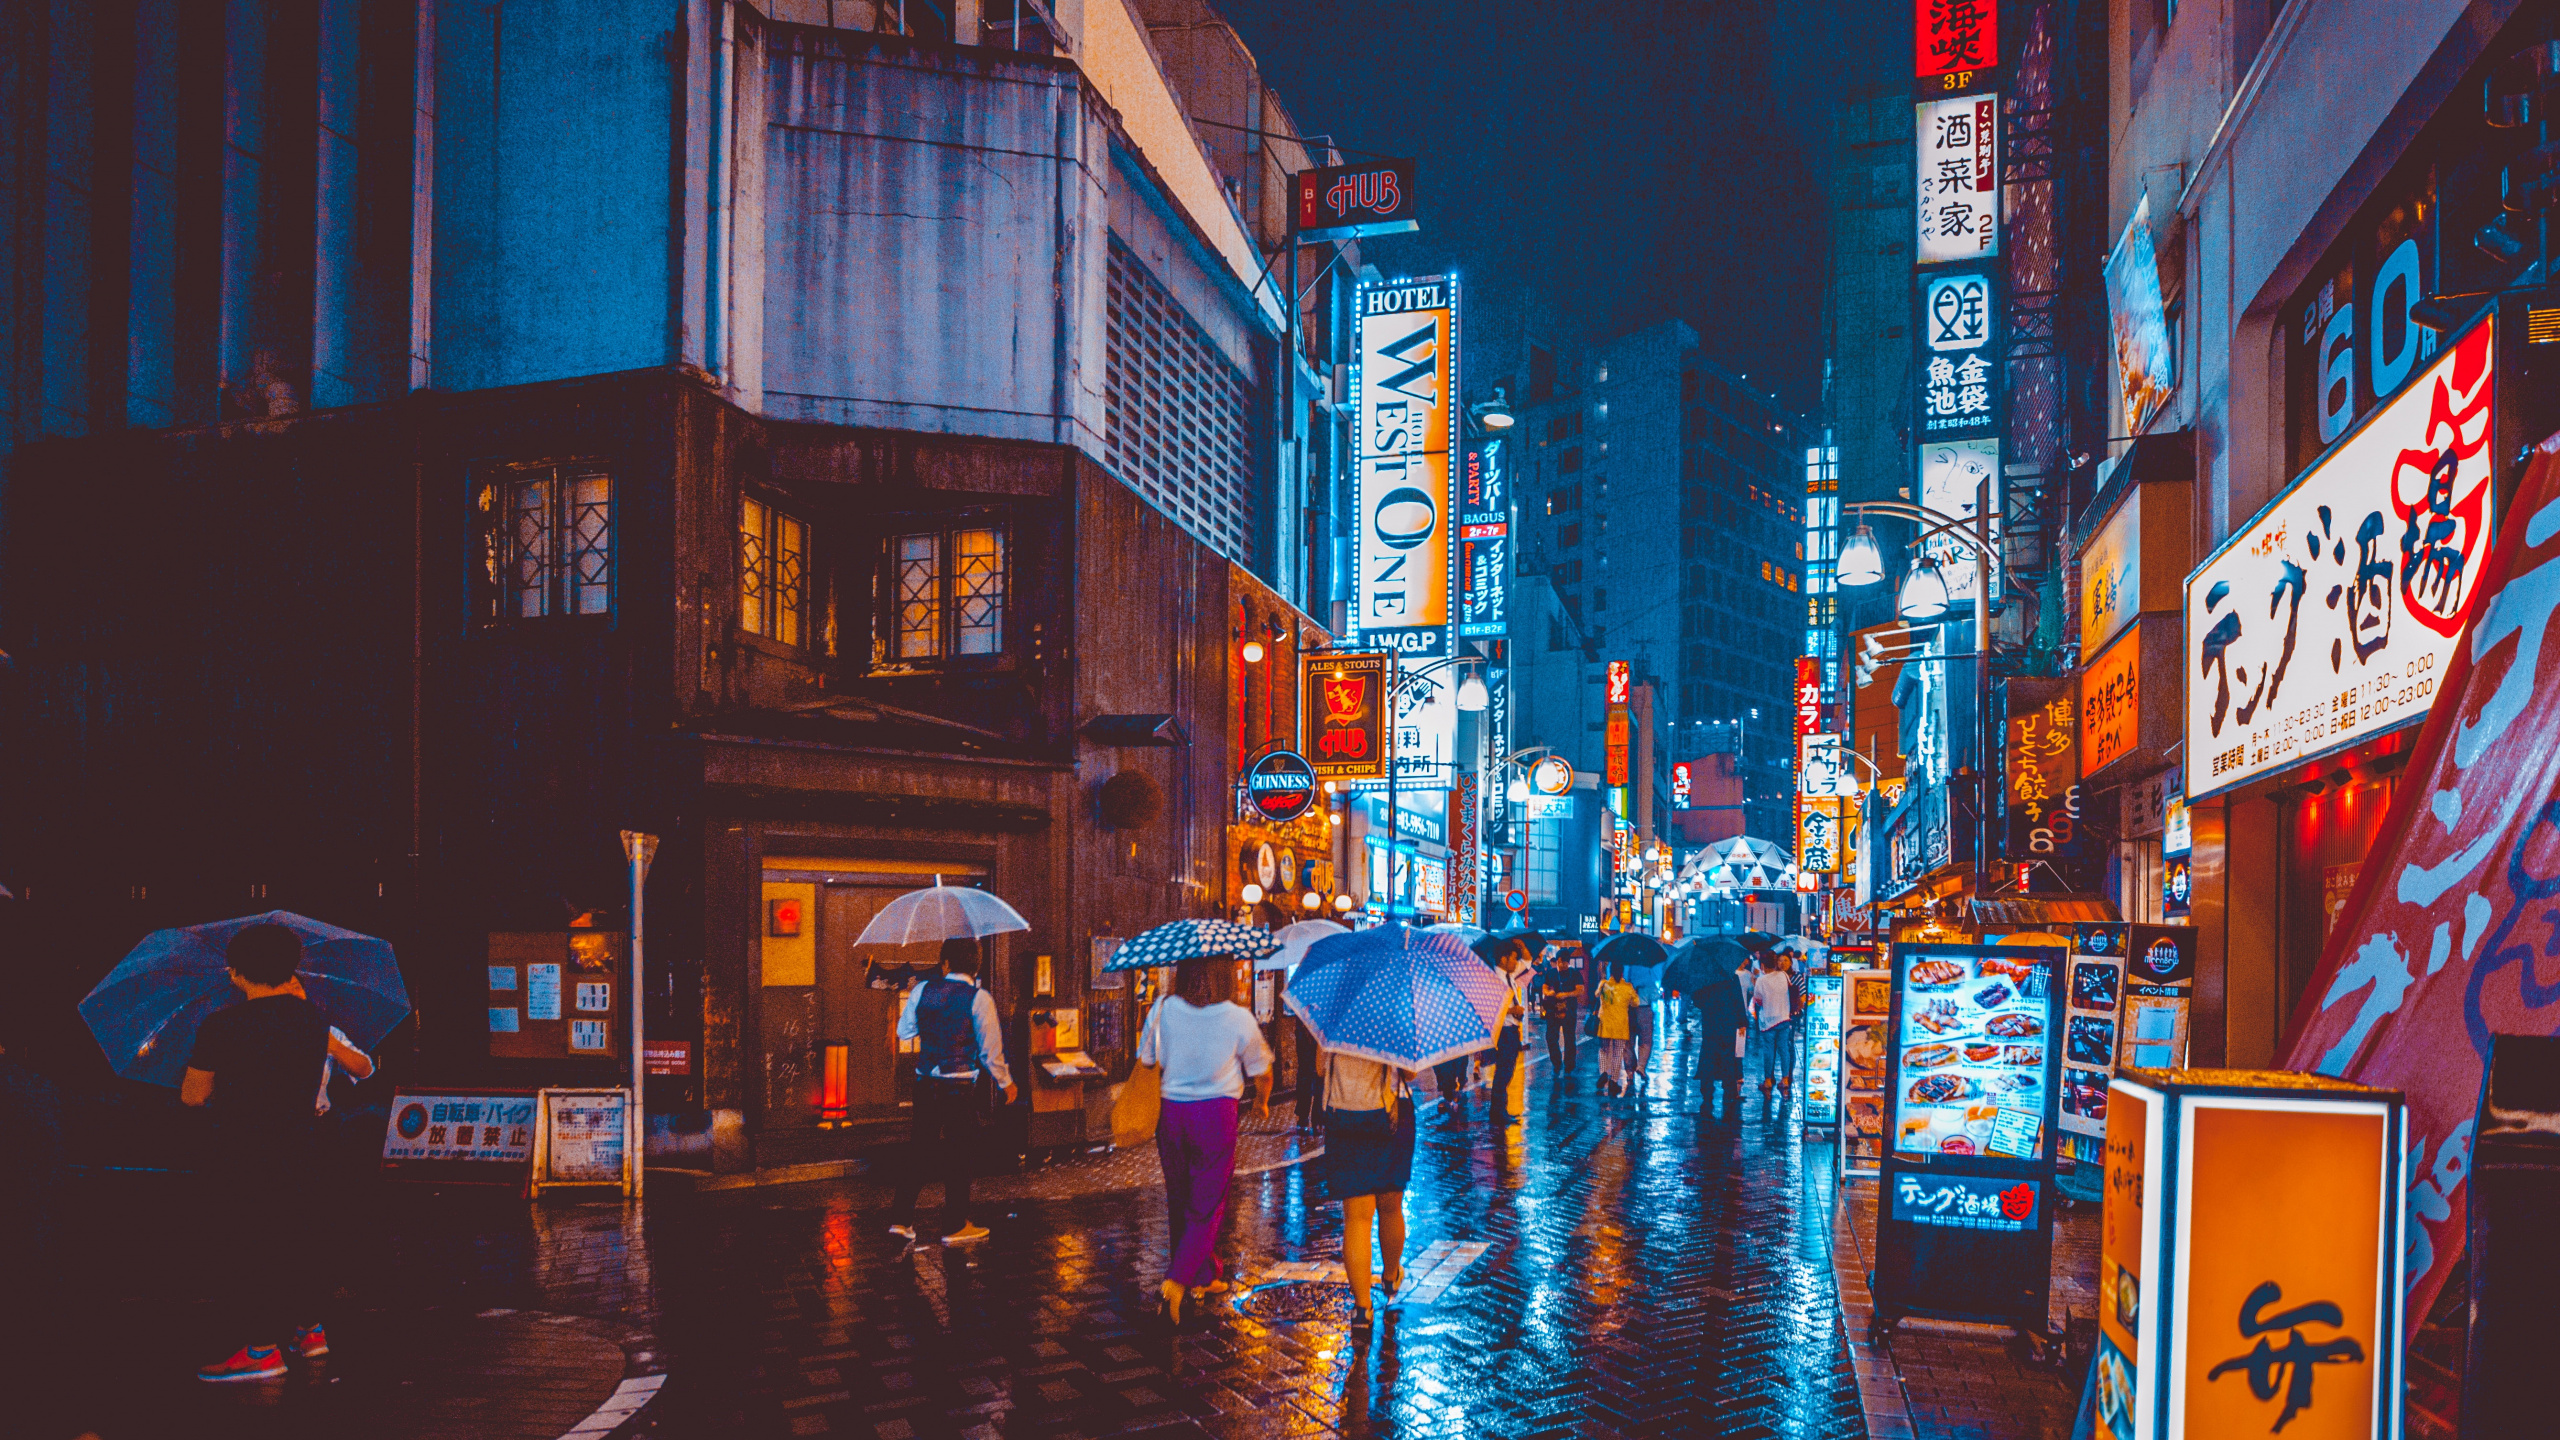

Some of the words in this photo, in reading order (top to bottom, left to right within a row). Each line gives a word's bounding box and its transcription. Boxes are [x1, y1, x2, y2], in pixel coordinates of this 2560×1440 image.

[1943, 71, 1972, 90] 3F
[1936, 114, 1974, 236] 酒菜家
[1327, 170, 1400, 218] HUB
[1921, 178, 1935, 241] さかなや
[1979, 214, 1993, 250] 2F
[1367, 286, 1446, 315] HOTEL
[1926, 353, 1992, 388] 魚金
[1373, 316, 1438, 480] WEST
[1926, 386, 1991, 415] 池袋
[1411, 411, 1424, 466] HOTEL
[1926, 415, 1992, 430] 創業昭和48年
[1468, 462, 1480, 505] PARTY
[1484, 440, 1501, 511] ダーツバー
[1464, 512, 1505, 524] BAGUS
[1469, 526, 1499, 537] 2F-7F
[1373, 486, 1437, 618] ONE
[1490, 540, 1503, 621] インターネット
[2201, 448, 2465, 738] テング酒場
[1465, 626, 1503, 636] B1F-B2F
[1310, 662, 1334, 672] ALES
[1344, 660, 1380, 670] STOUTS
[1800, 684, 1819, 734] カラ
[1319, 728, 1368, 759] HUB
[1252, 773, 1310, 790] GUINNESS
[1346, 765, 1376, 775] CHIPS
[1803, 811, 1832, 871] 金の蔵
[1831, 953, 1843, 963] 4F
[431, 1102, 531, 1124] 自転車・バイク
[427, 1126, 527, 1147] 放置禁止
[1900, 1177, 2000, 1217] テング酒場
